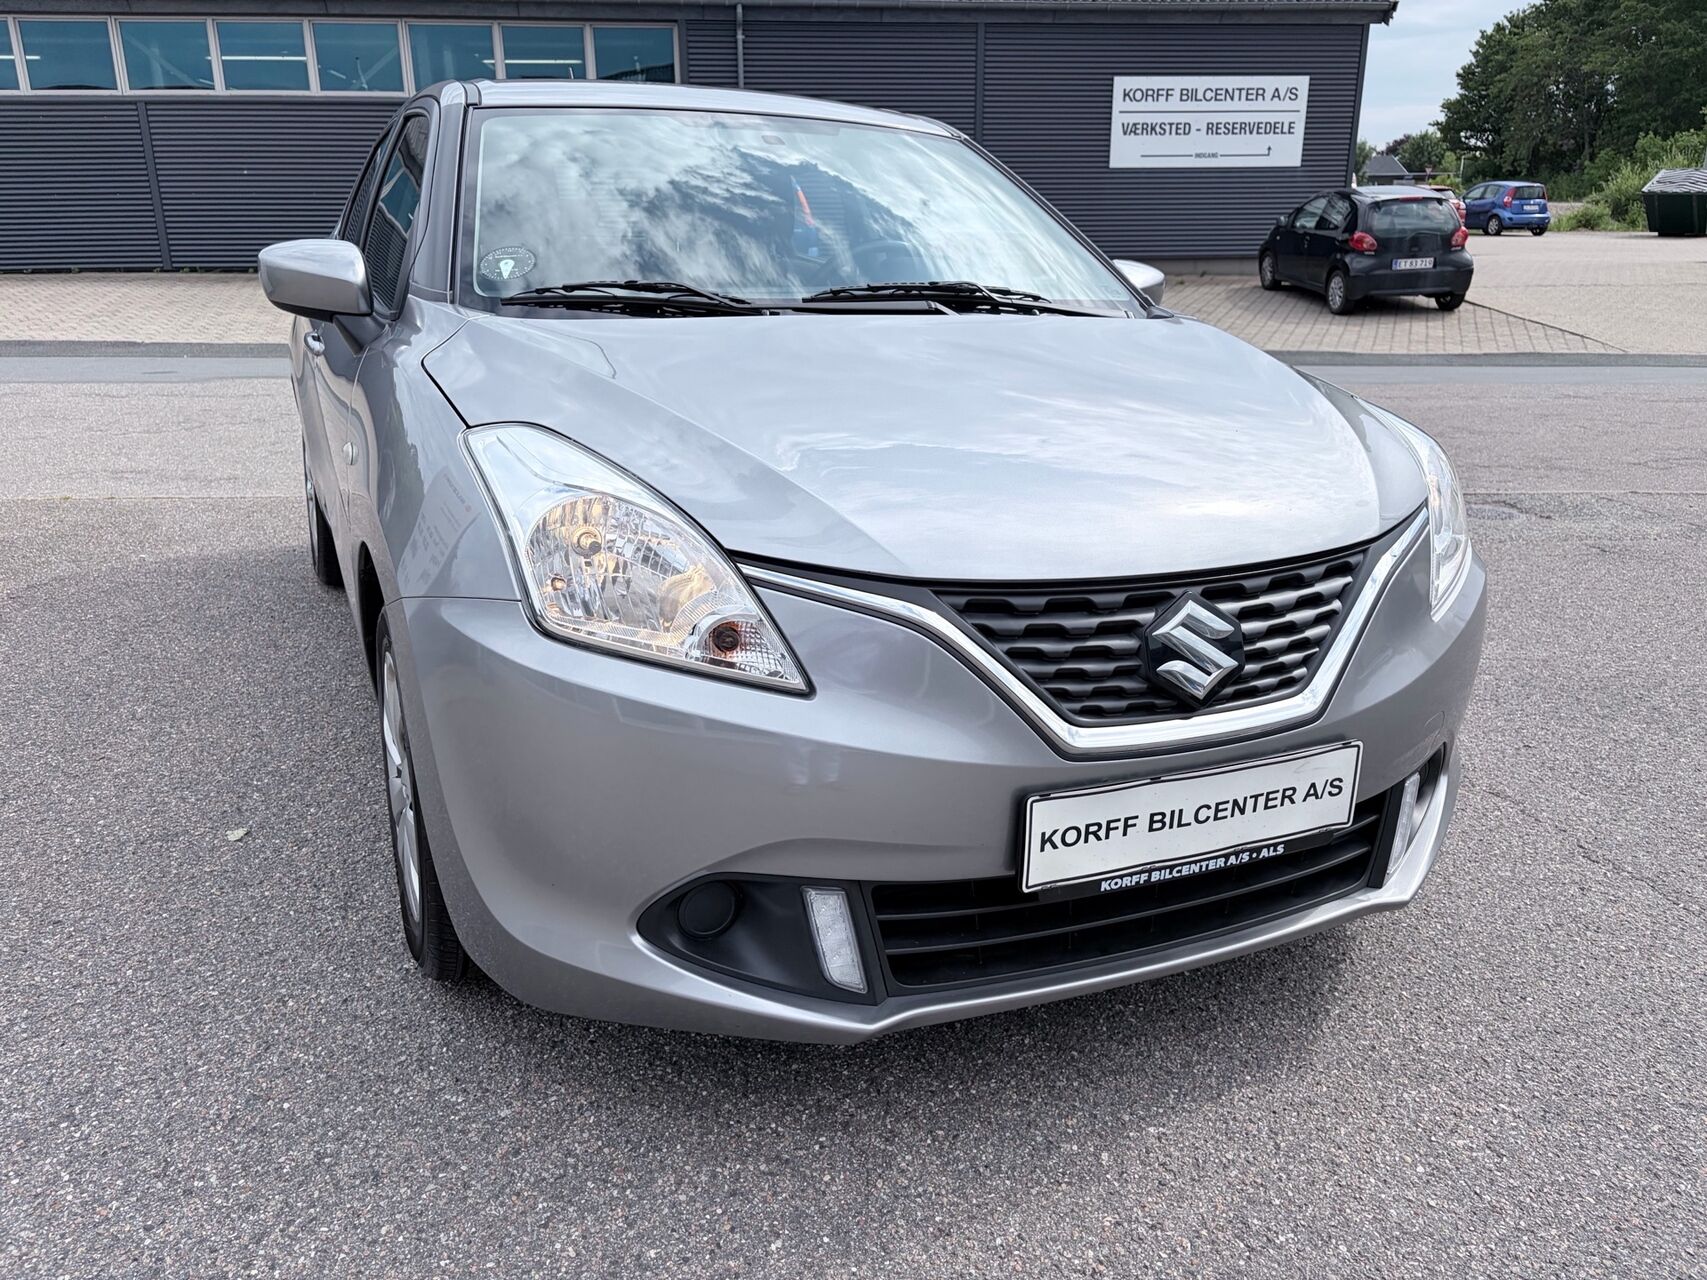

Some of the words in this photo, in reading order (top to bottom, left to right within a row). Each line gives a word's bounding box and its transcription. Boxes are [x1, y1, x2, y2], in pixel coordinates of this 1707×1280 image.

[1122, 88, 1174, 102] KORFF
[1179, 87, 1266, 102] BILCENTER
[1270, 86, 1299, 102] A/S
[1121, 122, 1192, 136] VÆRKSTED
[1205, 121, 1296, 136] RESERVEDELE
[1039, 815, 1139, 853] KORFF
[1147, 786, 1298, 834] BILCENTER
[1302, 777, 1345, 803] A/S
[1100, 872, 1149, 893] KORFF
[1149, 857, 1225, 883] BILCENTER
[1226, 851, 1251, 867] A/S
[1258, 844, 1285, 859] ALS
